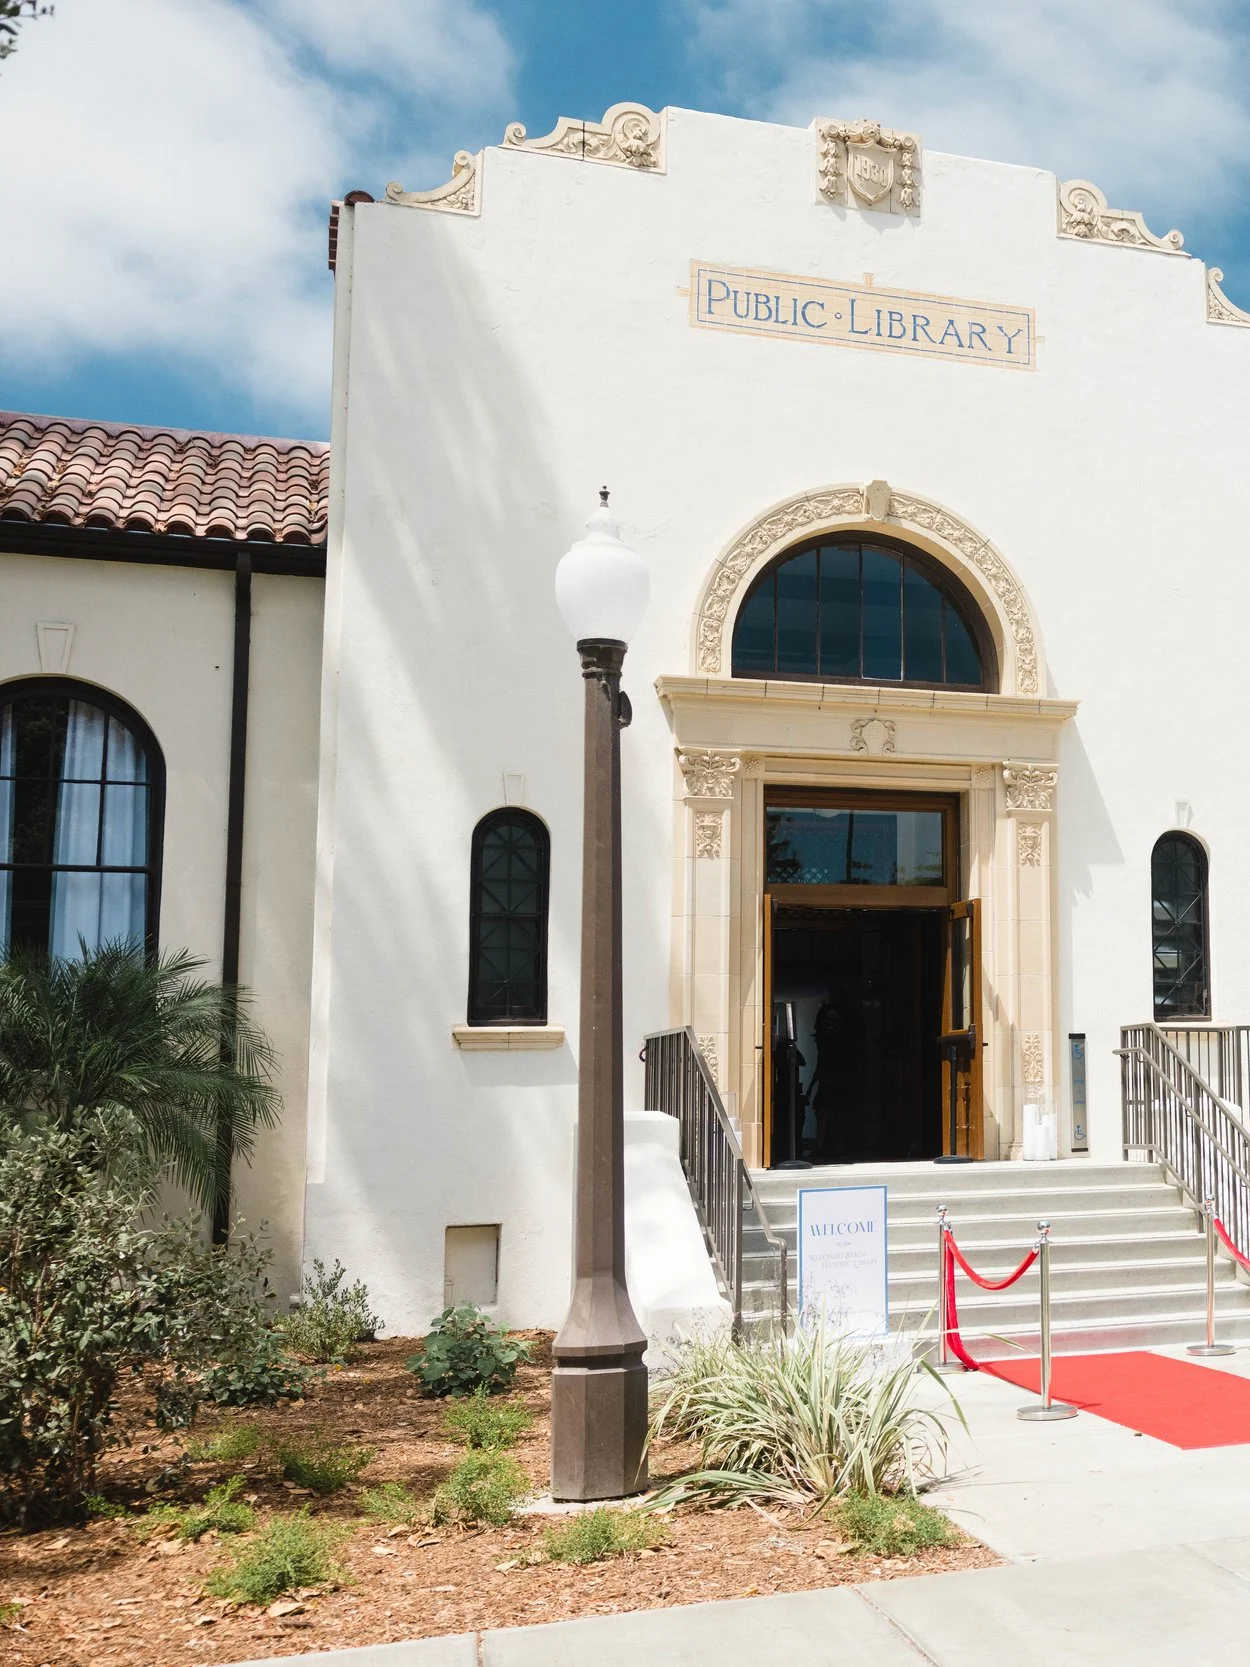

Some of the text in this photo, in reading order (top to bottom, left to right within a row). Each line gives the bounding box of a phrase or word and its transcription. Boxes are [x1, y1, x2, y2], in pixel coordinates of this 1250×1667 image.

[854, 155, 889, 187] 1930
[706, 278, 1024, 354] PUBLIC LIBRARY
[810, 1219, 877, 1236] WELCOME
